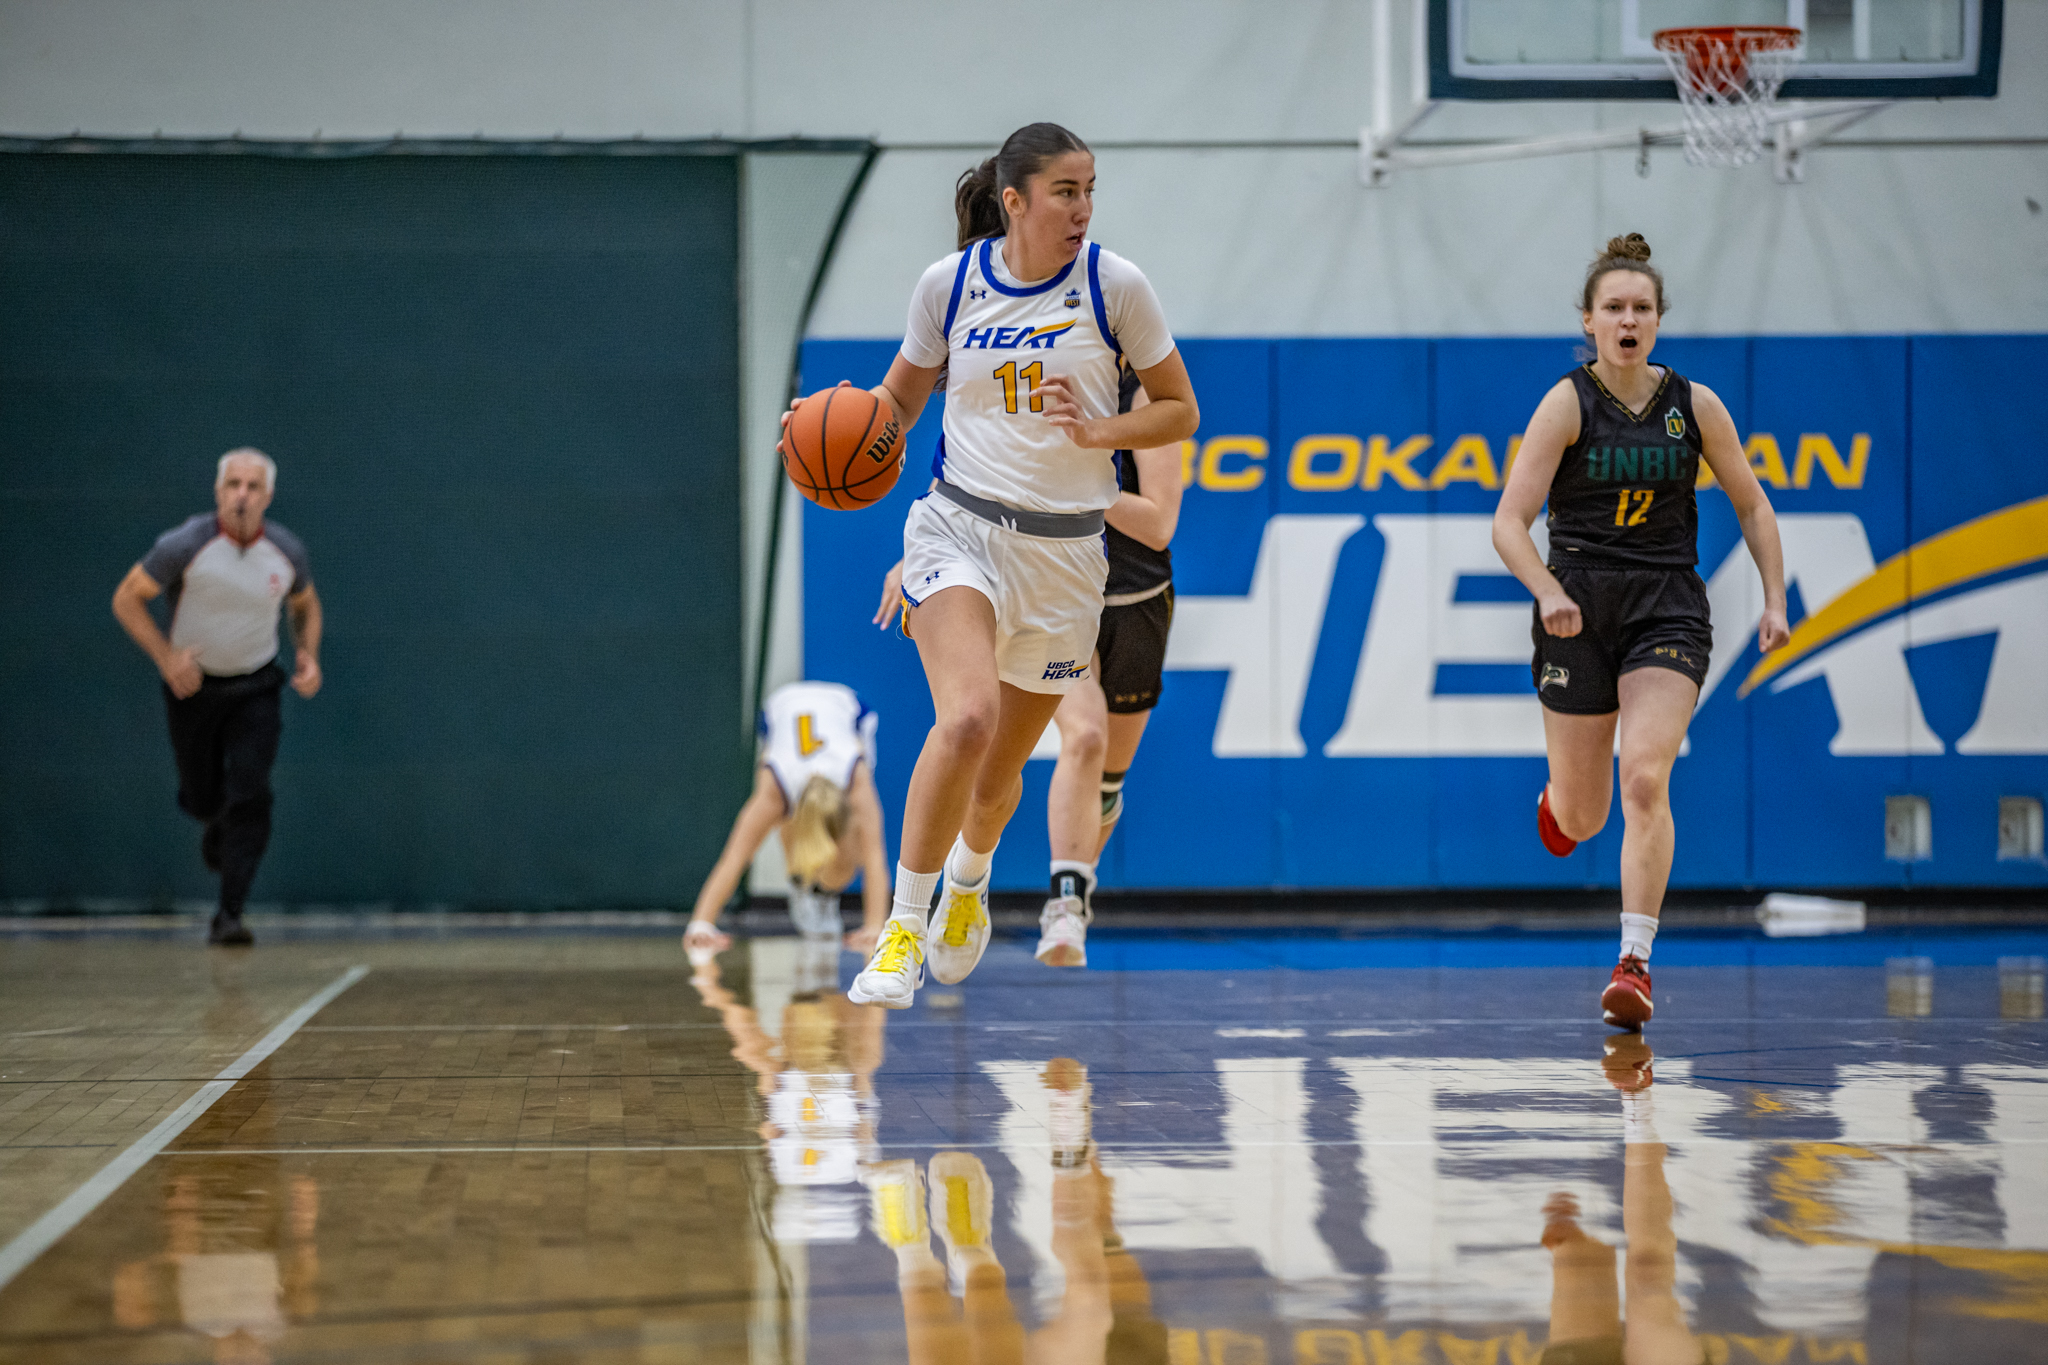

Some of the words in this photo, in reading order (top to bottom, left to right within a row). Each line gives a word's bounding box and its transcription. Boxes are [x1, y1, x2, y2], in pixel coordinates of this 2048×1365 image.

[963, 317, 1078, 349] HEAT
[993, 361, 1043, 414] 11
[1181, 435, 1269, 491] C
[1287, 434, 1872, 491] OKAAN
[1588, 446, 1688, 480] UNBC
[1615, 489, 1655, 526] 12
[1041, 664, 1089, 680] HEAT
[1047, 660, 1075, 669] UBCO
[797, 713, 824, 757] 1
